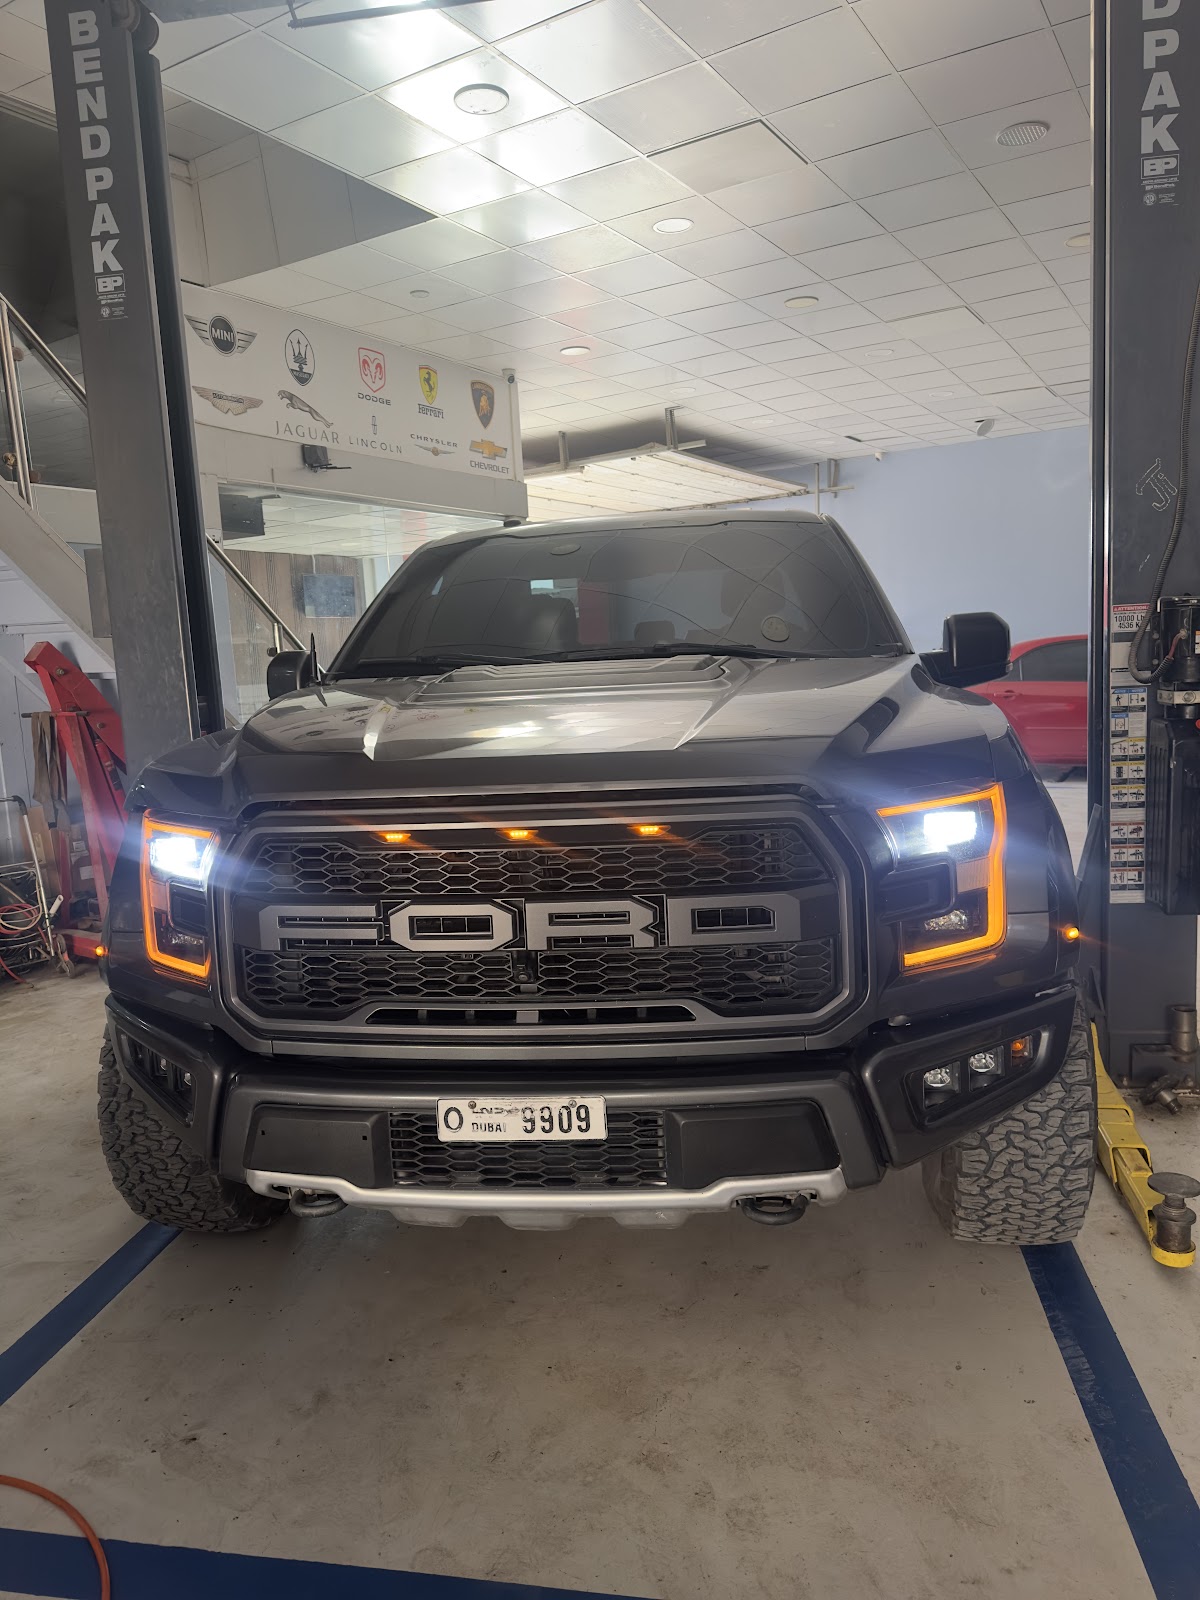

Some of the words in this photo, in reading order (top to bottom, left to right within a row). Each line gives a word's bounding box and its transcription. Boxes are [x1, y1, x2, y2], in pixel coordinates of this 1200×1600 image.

[68, 10, 124, 273] BENDPAK
[1143, 157, 1178, 177] BP
[97, 276, 123, 293] BP
[211, 327, 235, 343] MINI
[357, 392, 392, 406] DODGE
[417, 403, 445, 419] Ferrari
[275, 420, 340, 444] JAGUAR
[410, 433, 458, 448] CHRYSLER
[348, 436, 403, 454] LINCOLN
[469, 460, 510, 474] CHEVROLET
[259, 894, 801, 951] FORD
[471, 1122, 507, 1133] DUBAI
[520, 1104, 591, 1134] 9909
